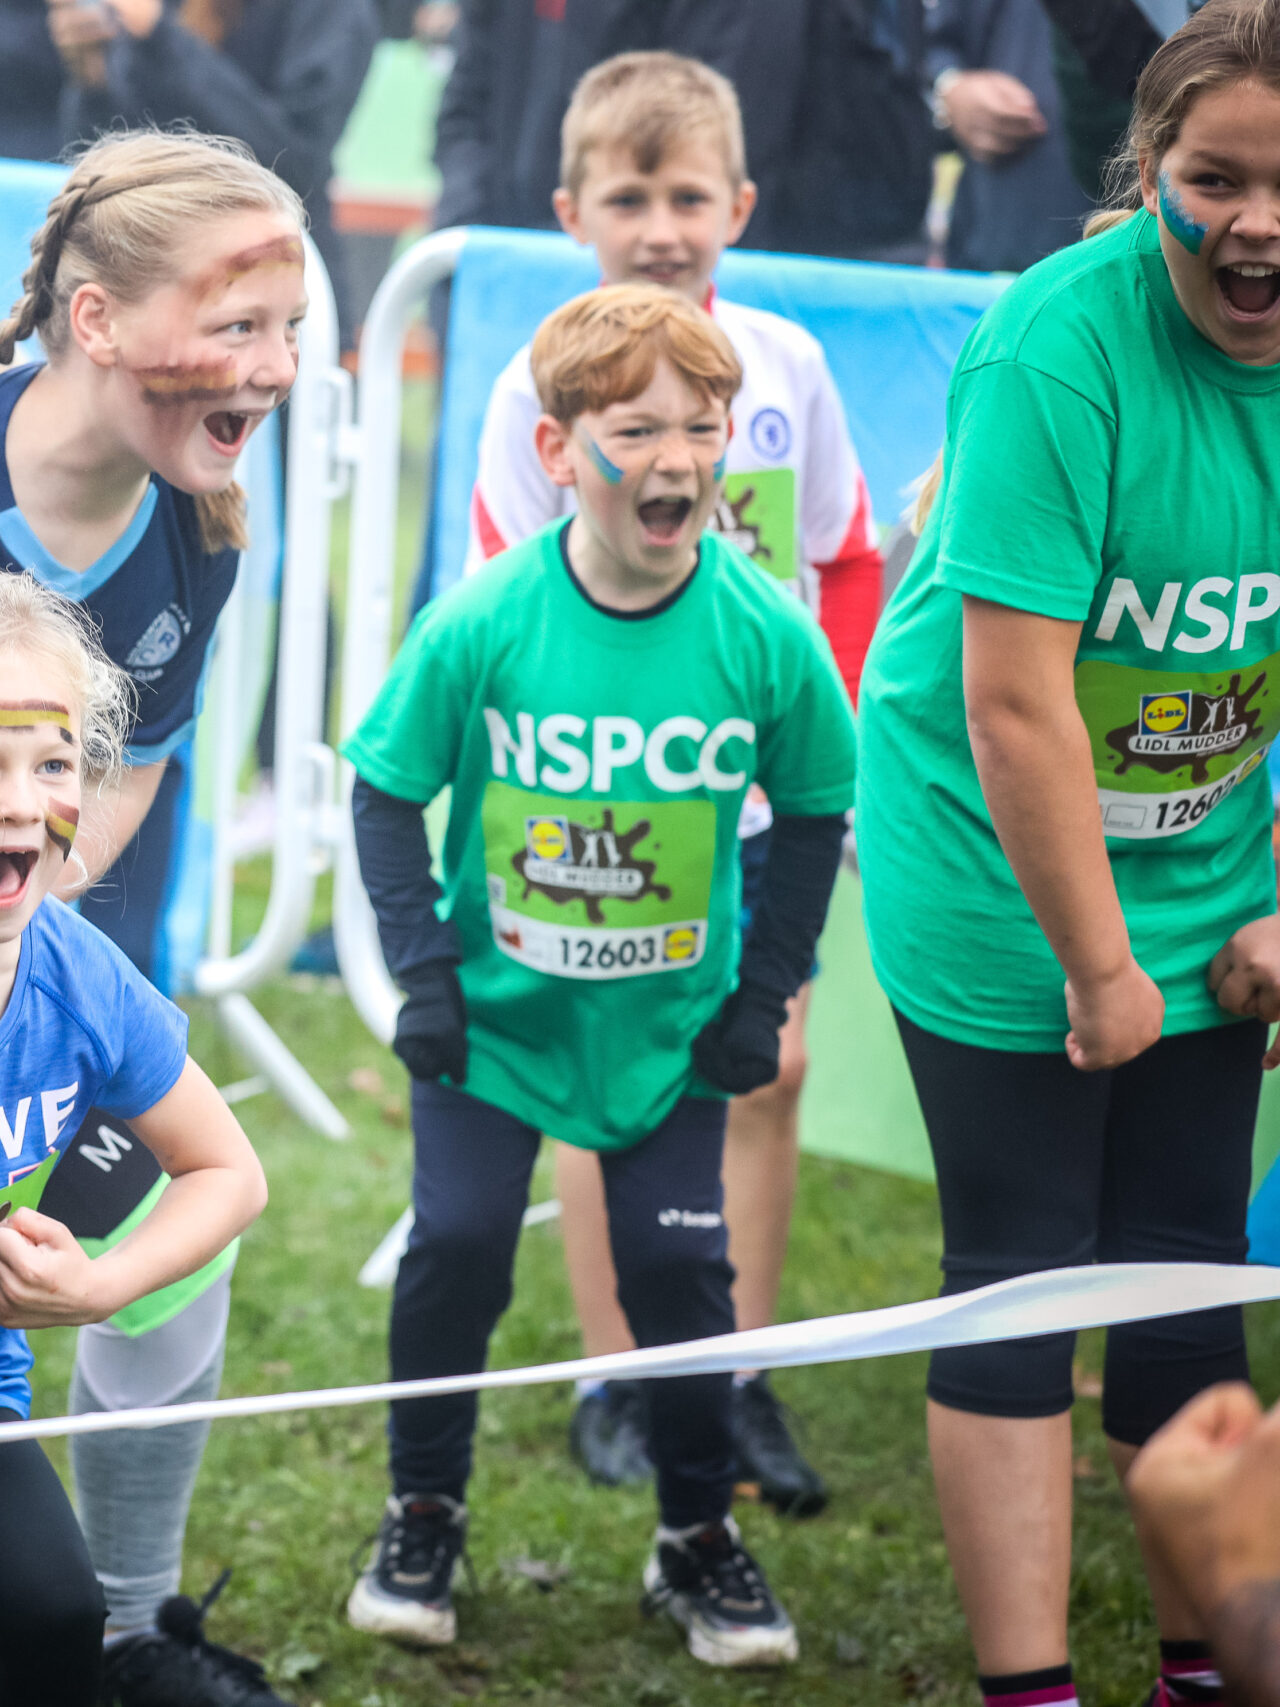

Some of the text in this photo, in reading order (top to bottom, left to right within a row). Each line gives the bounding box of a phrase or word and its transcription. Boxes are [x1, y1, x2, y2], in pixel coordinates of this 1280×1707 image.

[483, 707, 756, 793] NSPCC
[1135, 738, 1171, 751] LIDL
[1177, 726, 1243, 750] MUDDER
[562, 936, 656, 969] 12603
